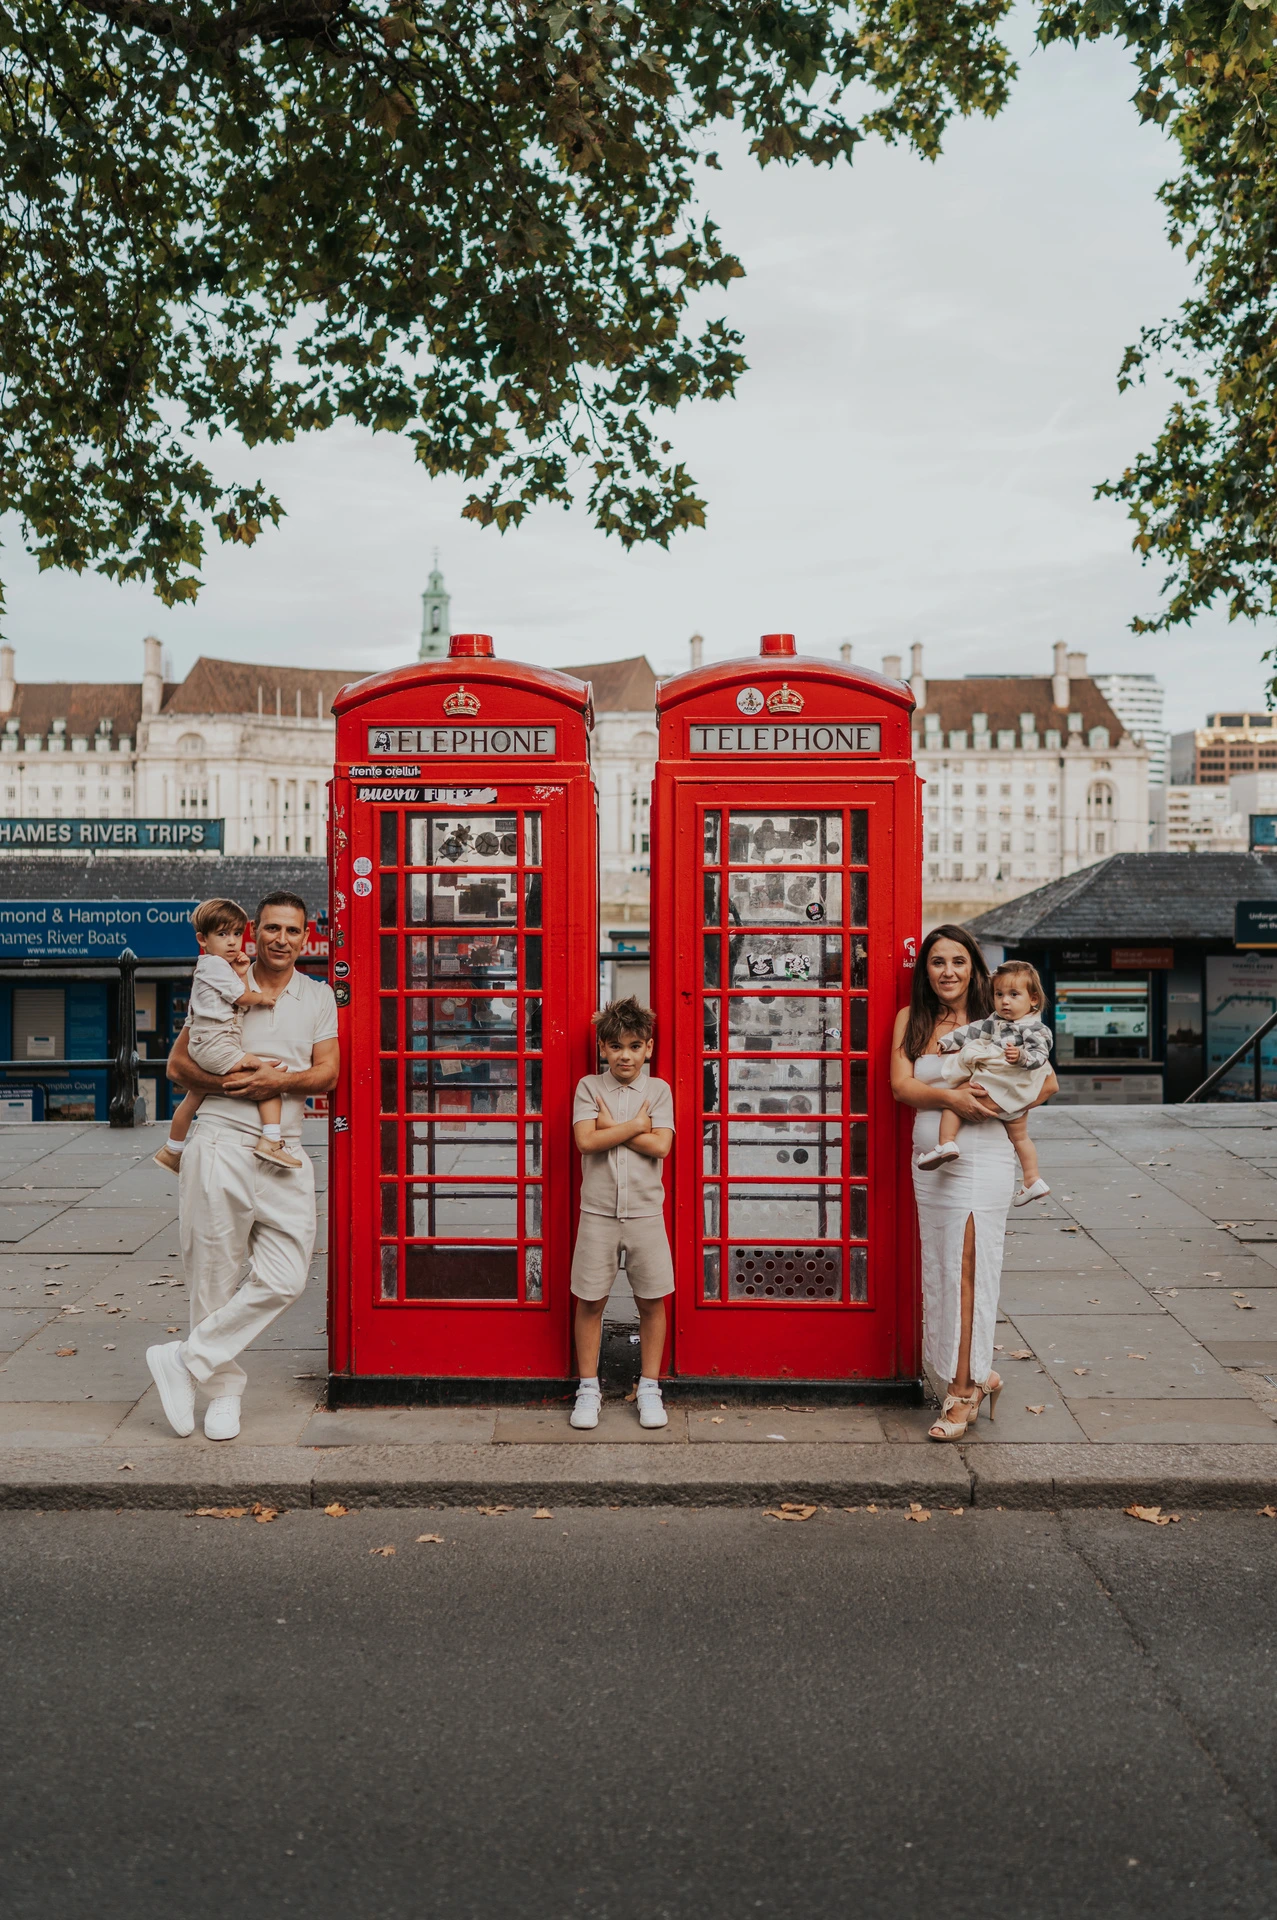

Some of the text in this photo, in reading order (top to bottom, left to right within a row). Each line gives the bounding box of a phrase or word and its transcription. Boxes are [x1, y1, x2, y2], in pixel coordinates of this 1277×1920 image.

[696, 727, 872, 750] TELEPHONE
[351, 766, 382, 776] frente
[358, 788, 419, 801] nueva
[0, 823, 205, 843] HAMES RIVER TRIPS
[52, 908, 64, 923] &
[69, 908, 141, 926] Hampton
[146, 908, 192, 923] Court
[47, 930, 84, 945] River
[88, 930, 127, 945] Boats
[299, 941, 329, 956] OUR
[74, 1081, 96, 1090] Court
